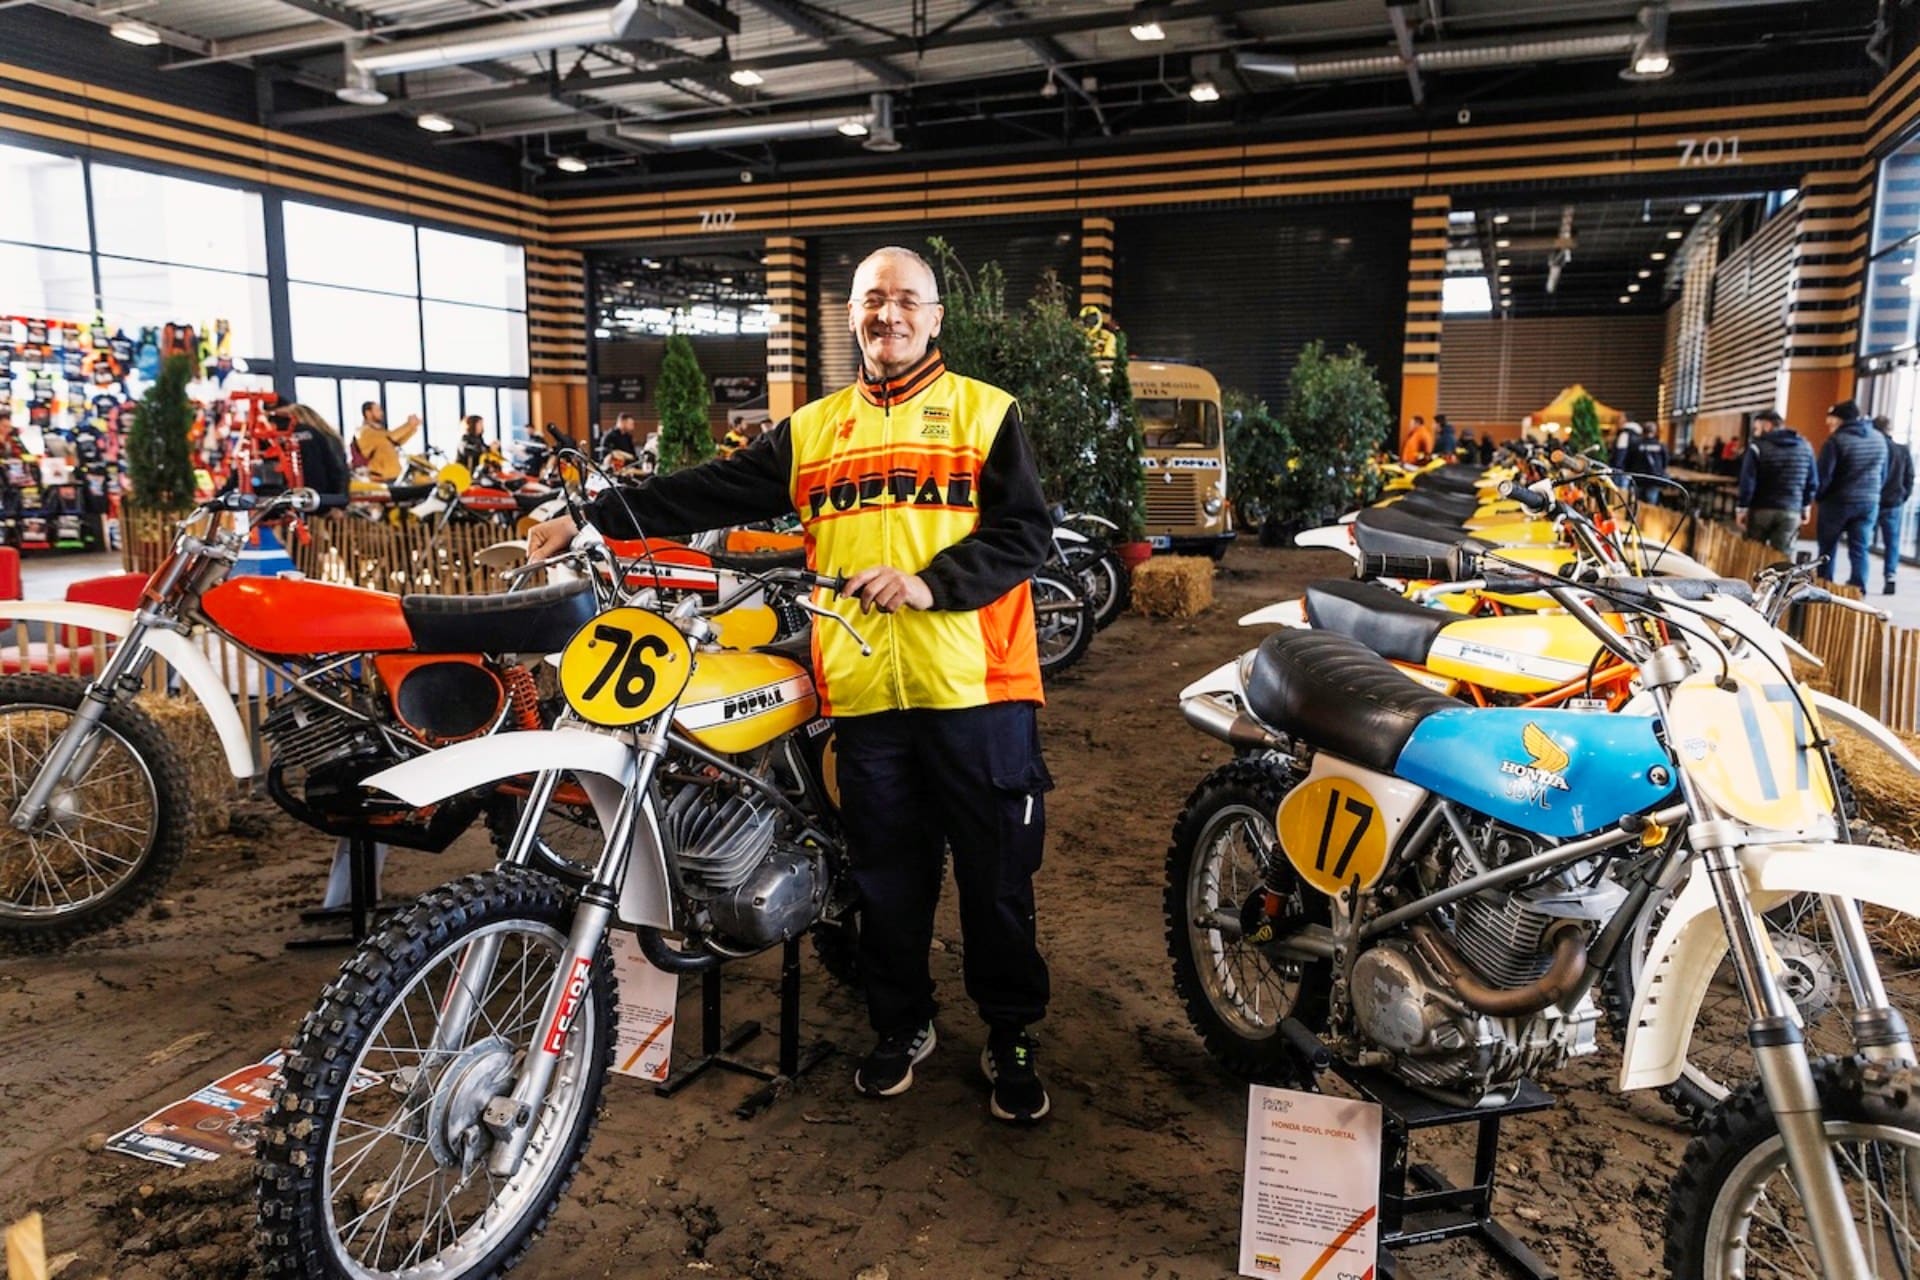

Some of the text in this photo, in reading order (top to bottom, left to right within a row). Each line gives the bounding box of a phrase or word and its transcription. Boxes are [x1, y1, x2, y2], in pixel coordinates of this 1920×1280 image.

[1677, 136, 1743, 168] 7.01
[697, 208, 736, 231] 7.02
[808, 468, 977, 519] PORTAL
[582, 624, 669, 709] 76
[723, 686, 785, 719] PORTAL
[1736, 683, 1809, 801] 17
[1500, 760, 1571, 792] HONDA
[1315, 788, 1374, 880] 17
[552, 962, 592, 1051] MOTUL
[1271, 1120, 1300, 1131] HONDA
[1325, 1128, 1357, 1141] PORTAL
